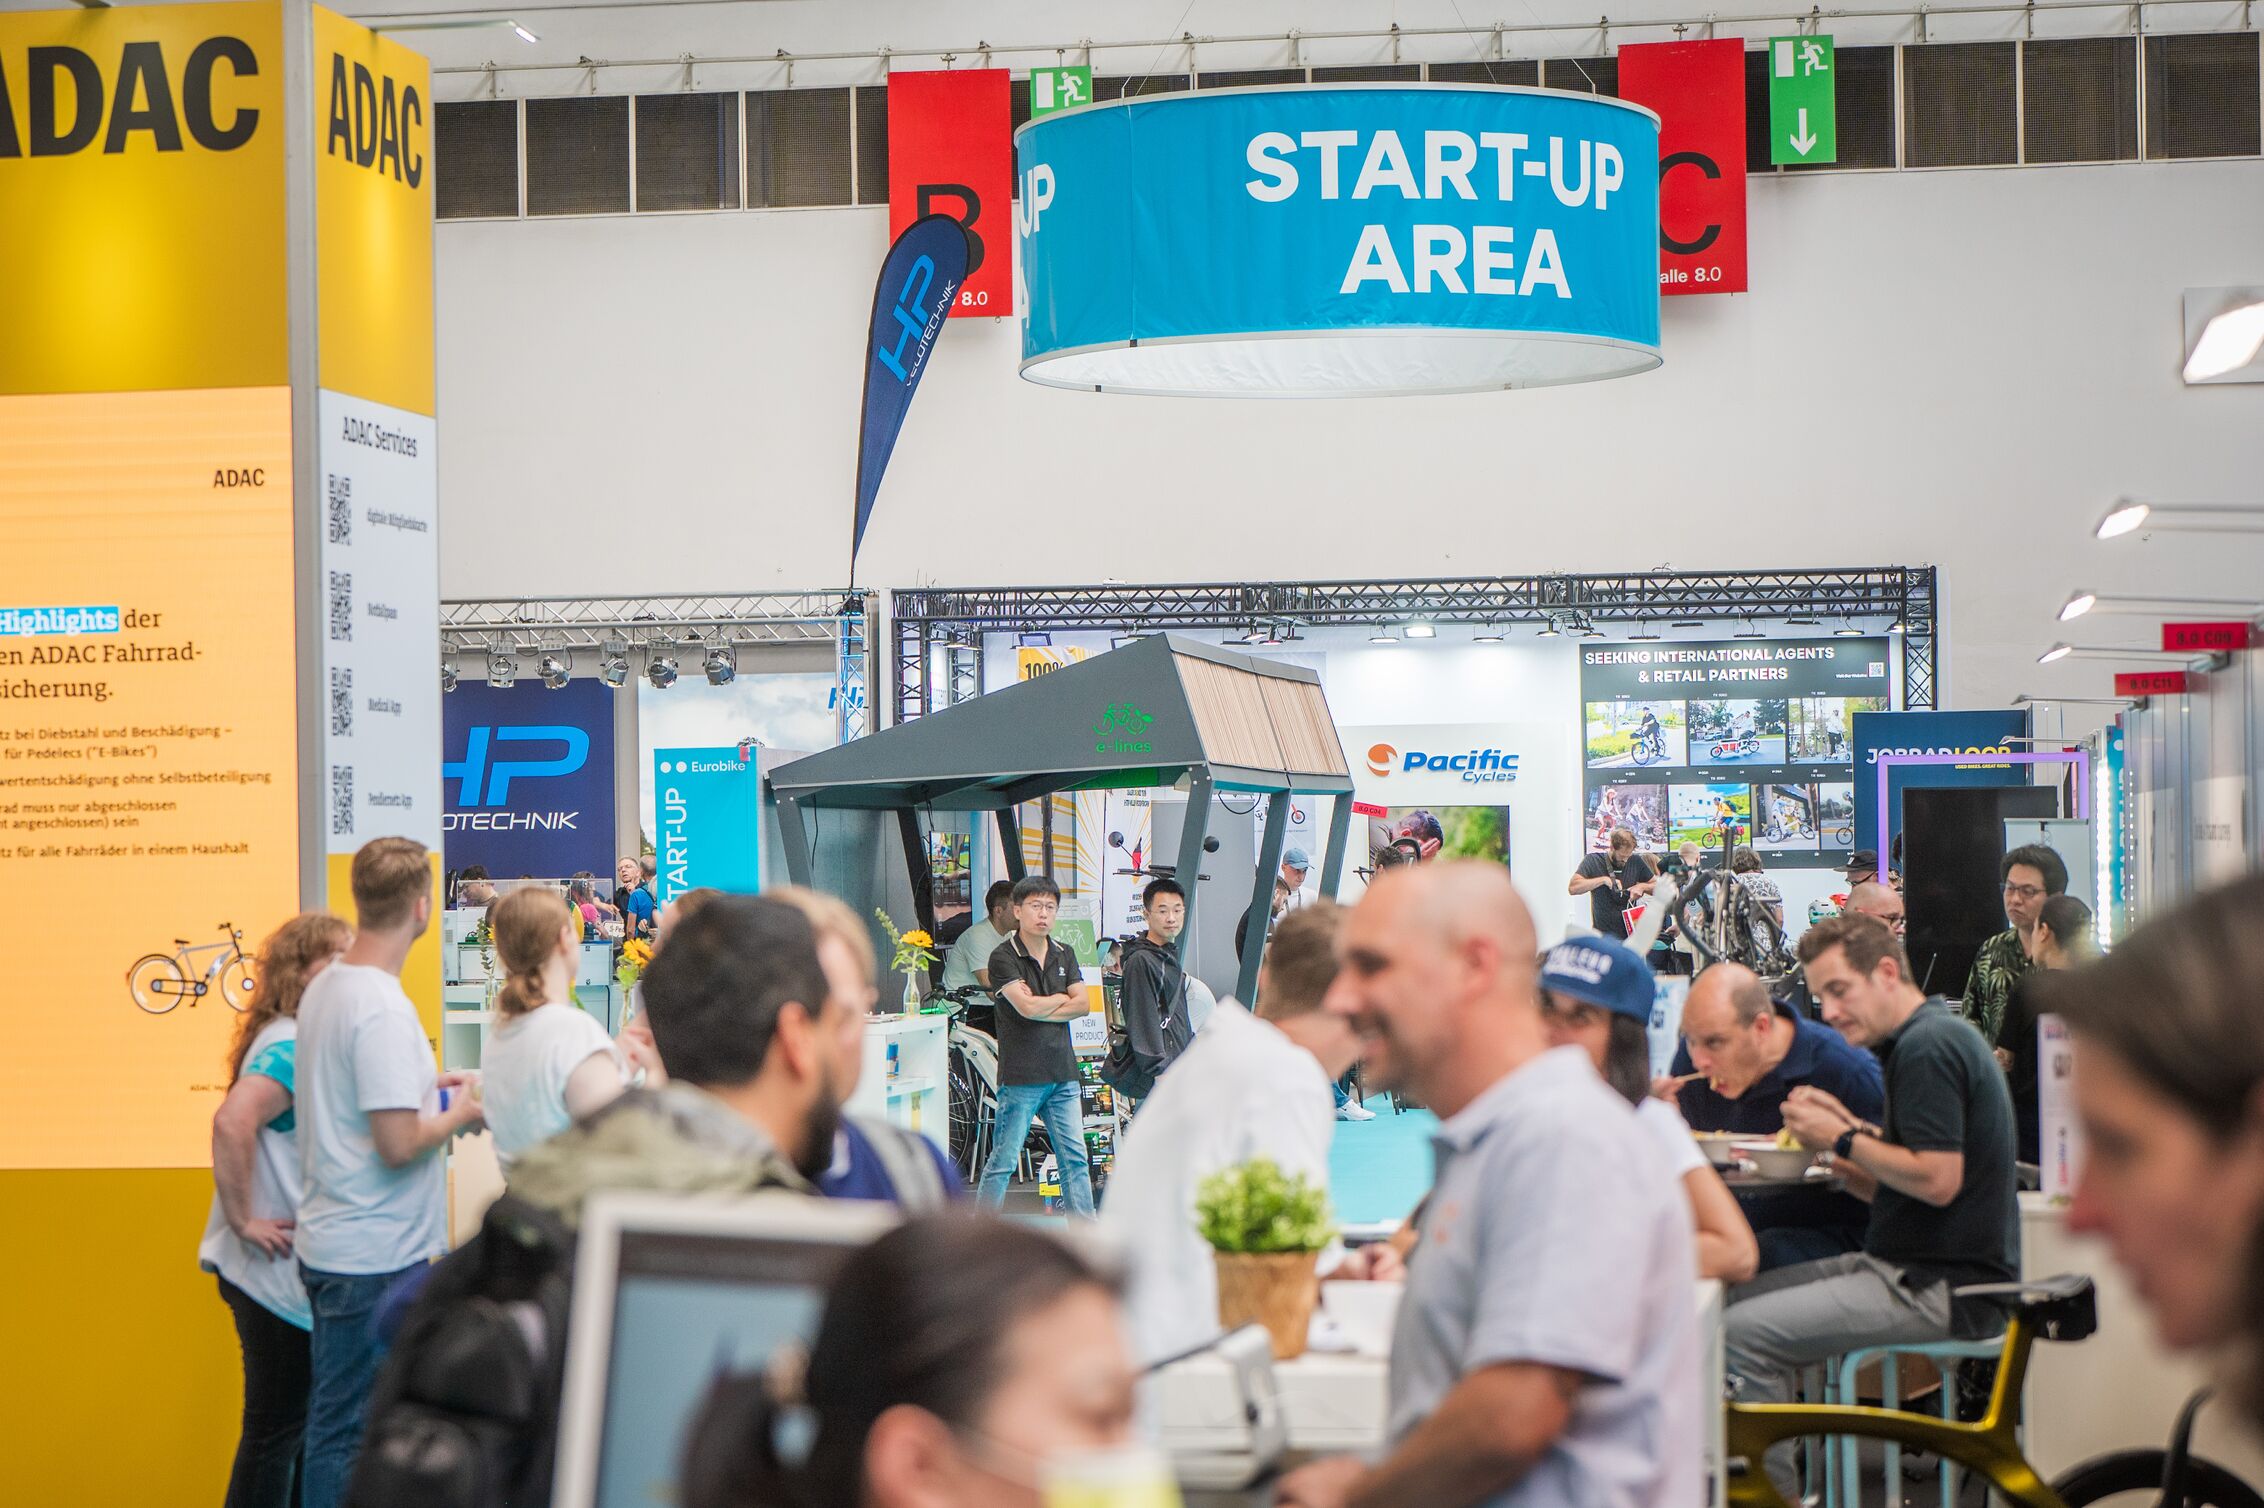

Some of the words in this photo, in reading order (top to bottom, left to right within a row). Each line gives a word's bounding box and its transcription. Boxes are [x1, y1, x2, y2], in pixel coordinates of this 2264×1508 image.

[0, 36, 260, 158] DAC
[328, 52, 422, 190] ADAC
[1246, 129, 1624, 210] START-UP
[1660, 151, 1722, 255] C
[1339, 224, 1572, 298] AREA
[1694, 266, 1722, 283] 8.0
[961, 291, 988, 306] 8.0
[878, 254, 935, 384] HP
[342, 416, 373, 447] ADAC
[375, 424, 418, 458] Services
[213, 468, 265, 488] ADAC
[124, 609, 162, 629] der
[30, 645, 97, 665] ADAC
[102, 641, 202, 663] Fahrrad-
[1585, 652, 1650, 665] SEEKING
[1653, 649, 1772, 663] INTERNATIONAL
[1774, 646, 1835, 660] AGENTS
[1638, 670, 1650, 683] &
[1653, 668, 1706, 683] RETAIL
[1708, 667, 1788, 682] PARTNERS
[0, 679, 114, 702] icherung.
[15, 729, 35, 740] bei
[38, 726, 99, 740] Diebstahl
[102, 727, 127, 738] und
[131, 725, 221, 739] Beschädigung
[4, 747, 22, 760] für
[27, 746, 83, 759] Pedelecs
[1096, 739, 1152, 753] e-lines
[691, 760, 746, 773] Eurobike
[1402, 748, 1520, 772] Pacific
[123, 773, 155, 785] ohne
[159, 770, 272, 785] Selbstbeteiligung
[1462, 770, 1517, 784] Cycles
[22, 804, 55, 813] muss
[59, 803, 80, 813] nur
[84, 800, 177, 815] abgeschlossen
[12, 817, 109, 832] angeschlossen)
[113, 816, 140, 828] sein
[17, 845, 35, 857] für
[40, 846, 62, 856] alle
[65, 844, 127, 856] Fahrräder
[131, 844, 145, 855] in
[148, 843, 188, 856] einem
[192, 842, 249, 854] Haushalt
[1082, 1018, 1096, 1028] NEW
[1075, 1030, 1104, 1042] PRODUCT
